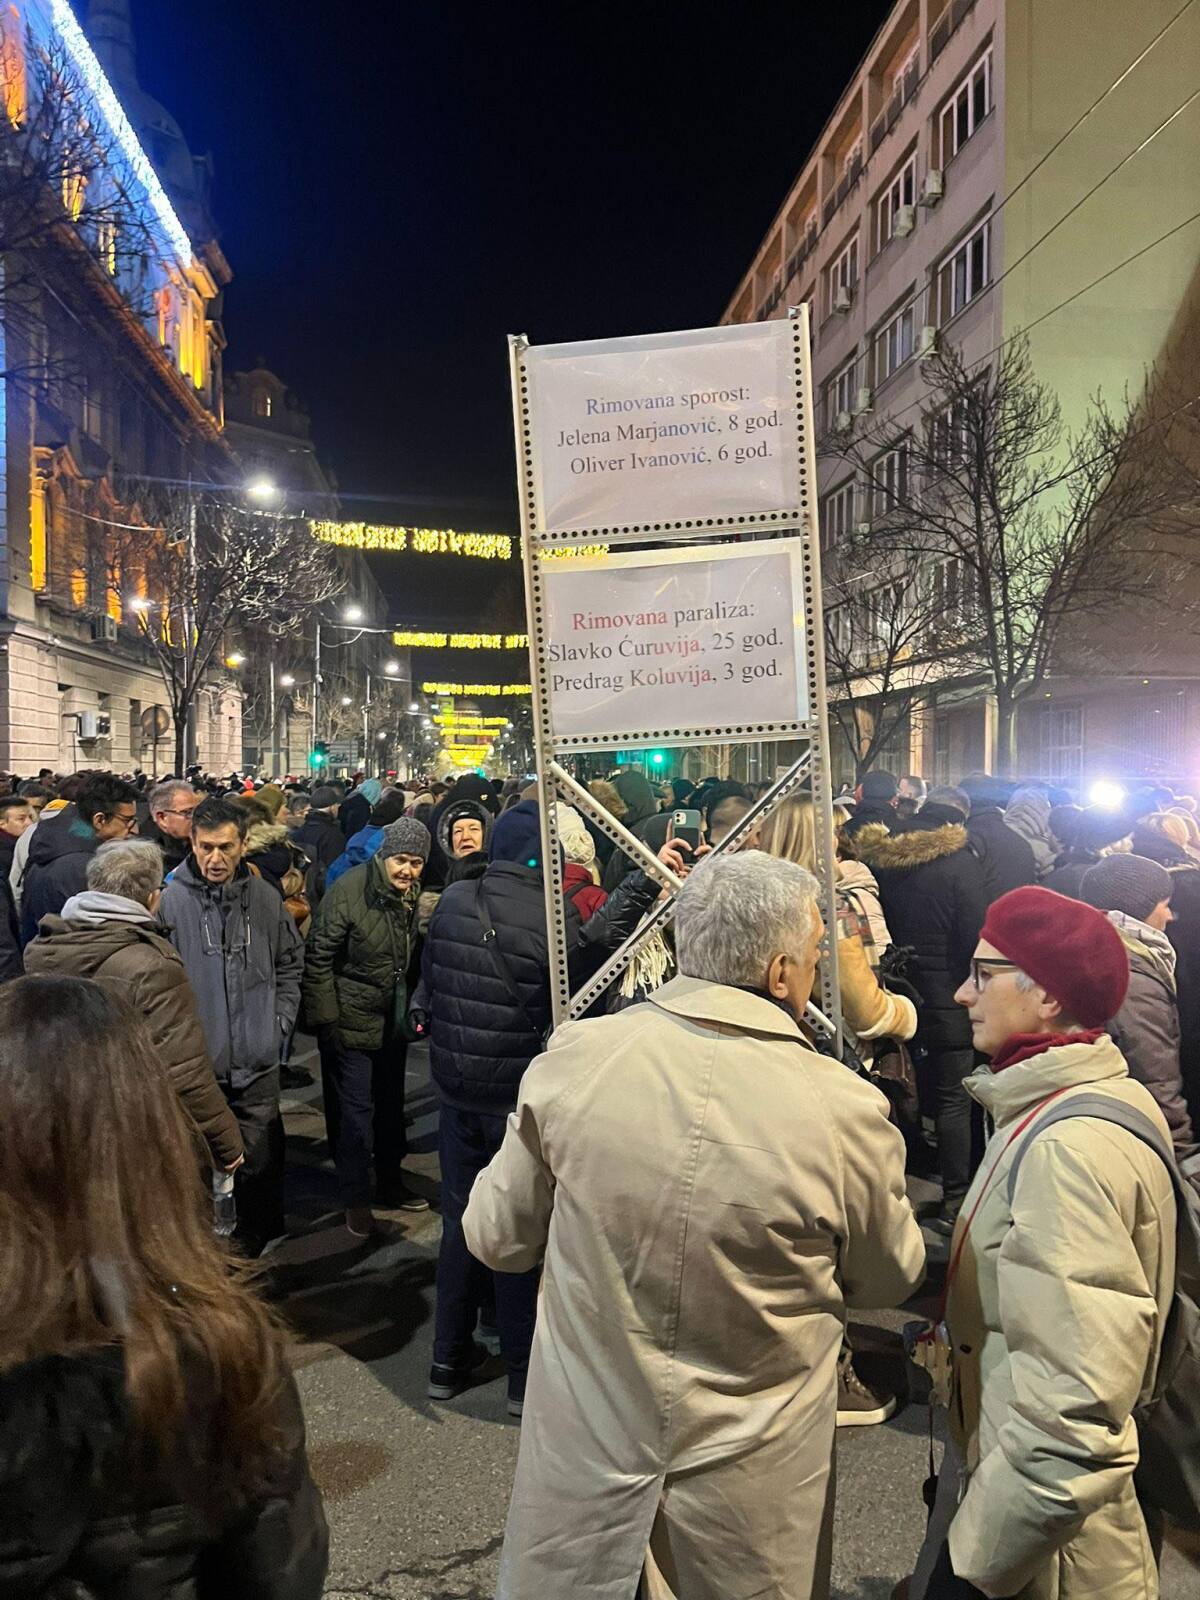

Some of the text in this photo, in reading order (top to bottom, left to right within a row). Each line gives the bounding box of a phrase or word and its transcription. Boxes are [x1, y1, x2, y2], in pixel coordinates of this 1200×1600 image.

[587, 386, 751, 416] Rimovana sporost:
[558, 429, 610, 448] Jelena
[728, 414, 739, 430] 8
[745, 410, 783, 431] god.
[570, 454, 625, 475] Oliver
[718, 445, 729, 461] 6
[735, 440, 773, 464] god.
[572, 602, 755, 631] Rimovana paraliza:
[549, 629, 784, 663] Slavko Ćuruvija, 25 god.
[553, 659, 783, 693] Predrag Koluvija, 3 god.
